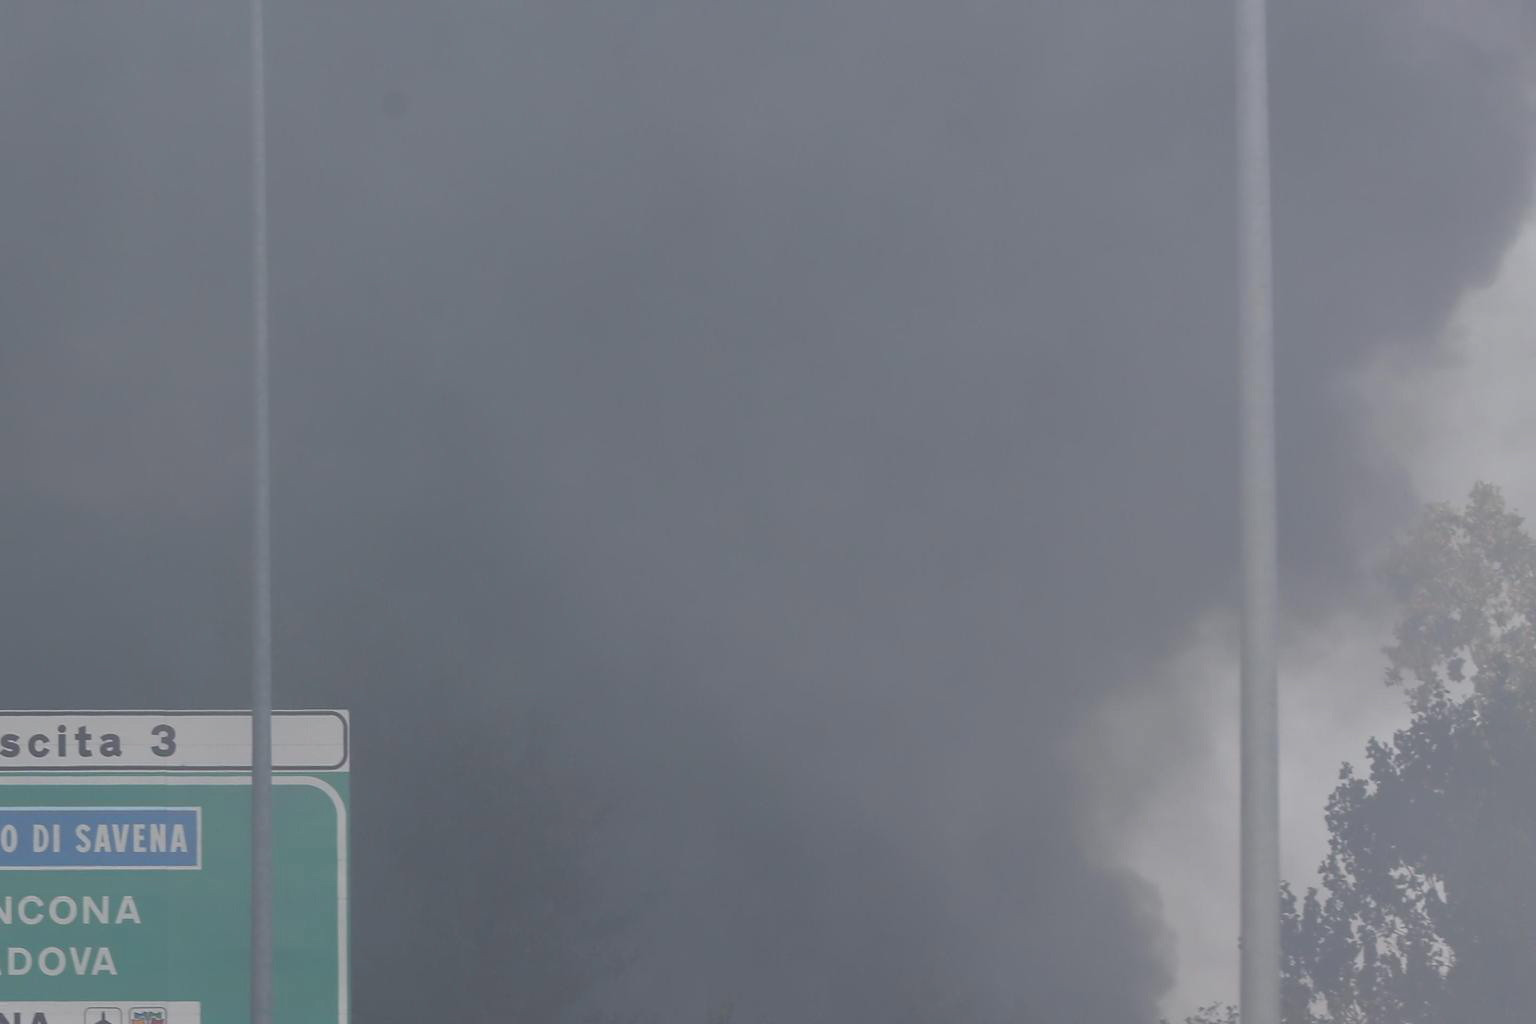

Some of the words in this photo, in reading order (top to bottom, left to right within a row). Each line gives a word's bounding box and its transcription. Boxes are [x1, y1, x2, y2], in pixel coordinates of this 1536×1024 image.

[150, 724, 178, 758] 3
[33, 824, 61, 853] DI
[75, 824, 188, 853] SAVENA
